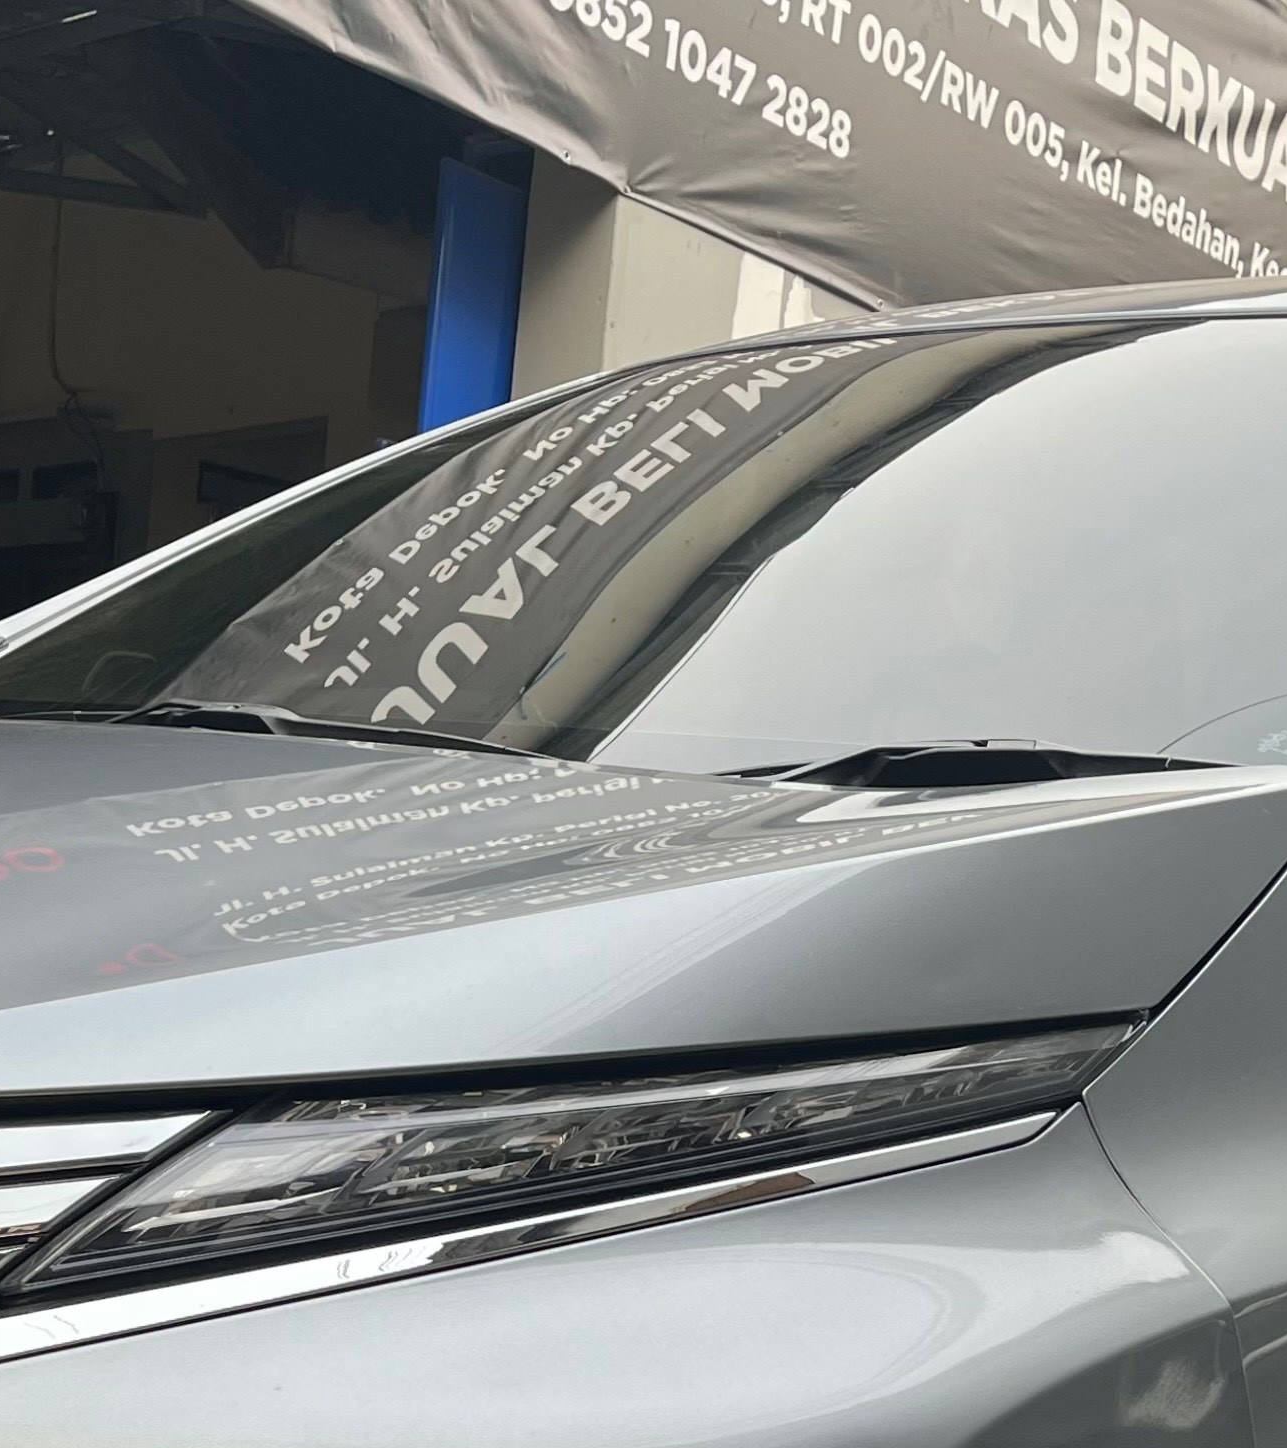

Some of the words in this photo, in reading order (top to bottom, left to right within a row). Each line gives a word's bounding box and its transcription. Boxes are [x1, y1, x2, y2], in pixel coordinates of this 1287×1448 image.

[549, 0, 653, 59] 852
[664, 18, 757, 106] 1047
[762, 74, 852, 159] 2828
[800, 0, 852, 46] RT
[858, 13, 1000, 129] 002/RW
[1004, 100, 1069, 182] 005,
[1077, 140, 1127, 207] Kel.
[1133, 173, 1244, 279] Bedahan,
